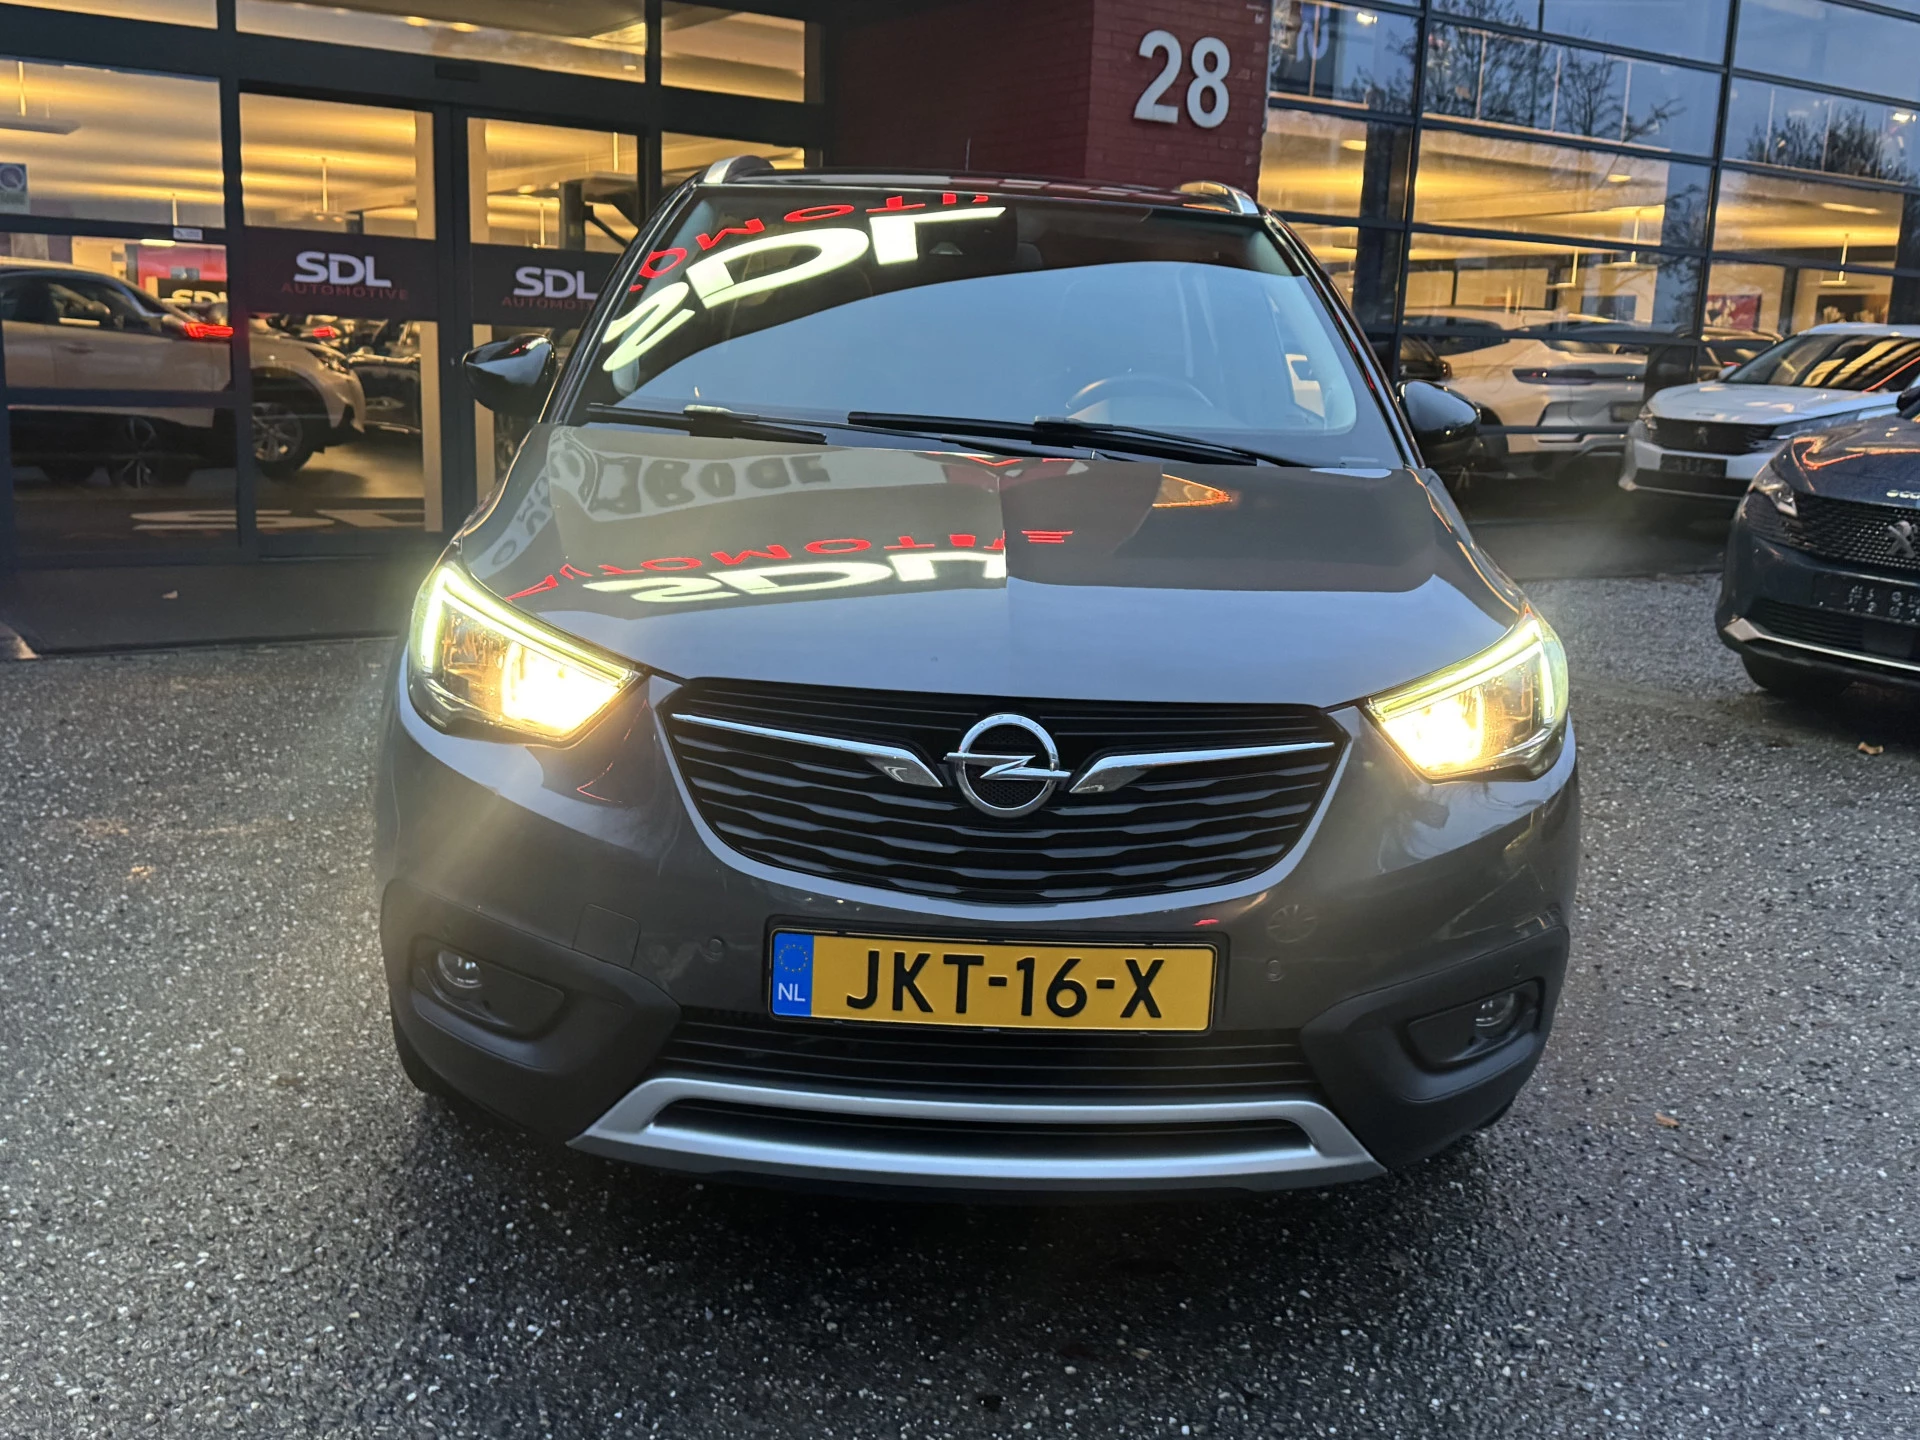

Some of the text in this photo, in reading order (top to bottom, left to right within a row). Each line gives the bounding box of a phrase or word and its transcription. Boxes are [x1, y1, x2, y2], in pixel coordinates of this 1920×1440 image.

[1133, 29, 1231, 129] 28
[293, 250, 393, 288] SDL
[512, 266, 599, 300] SDL
[281, 281, 409, 300] AUTOMOTIVE
[778, 982, 806, 1002] NL
[845, 949, 1165, 1019] JKT-16-X
